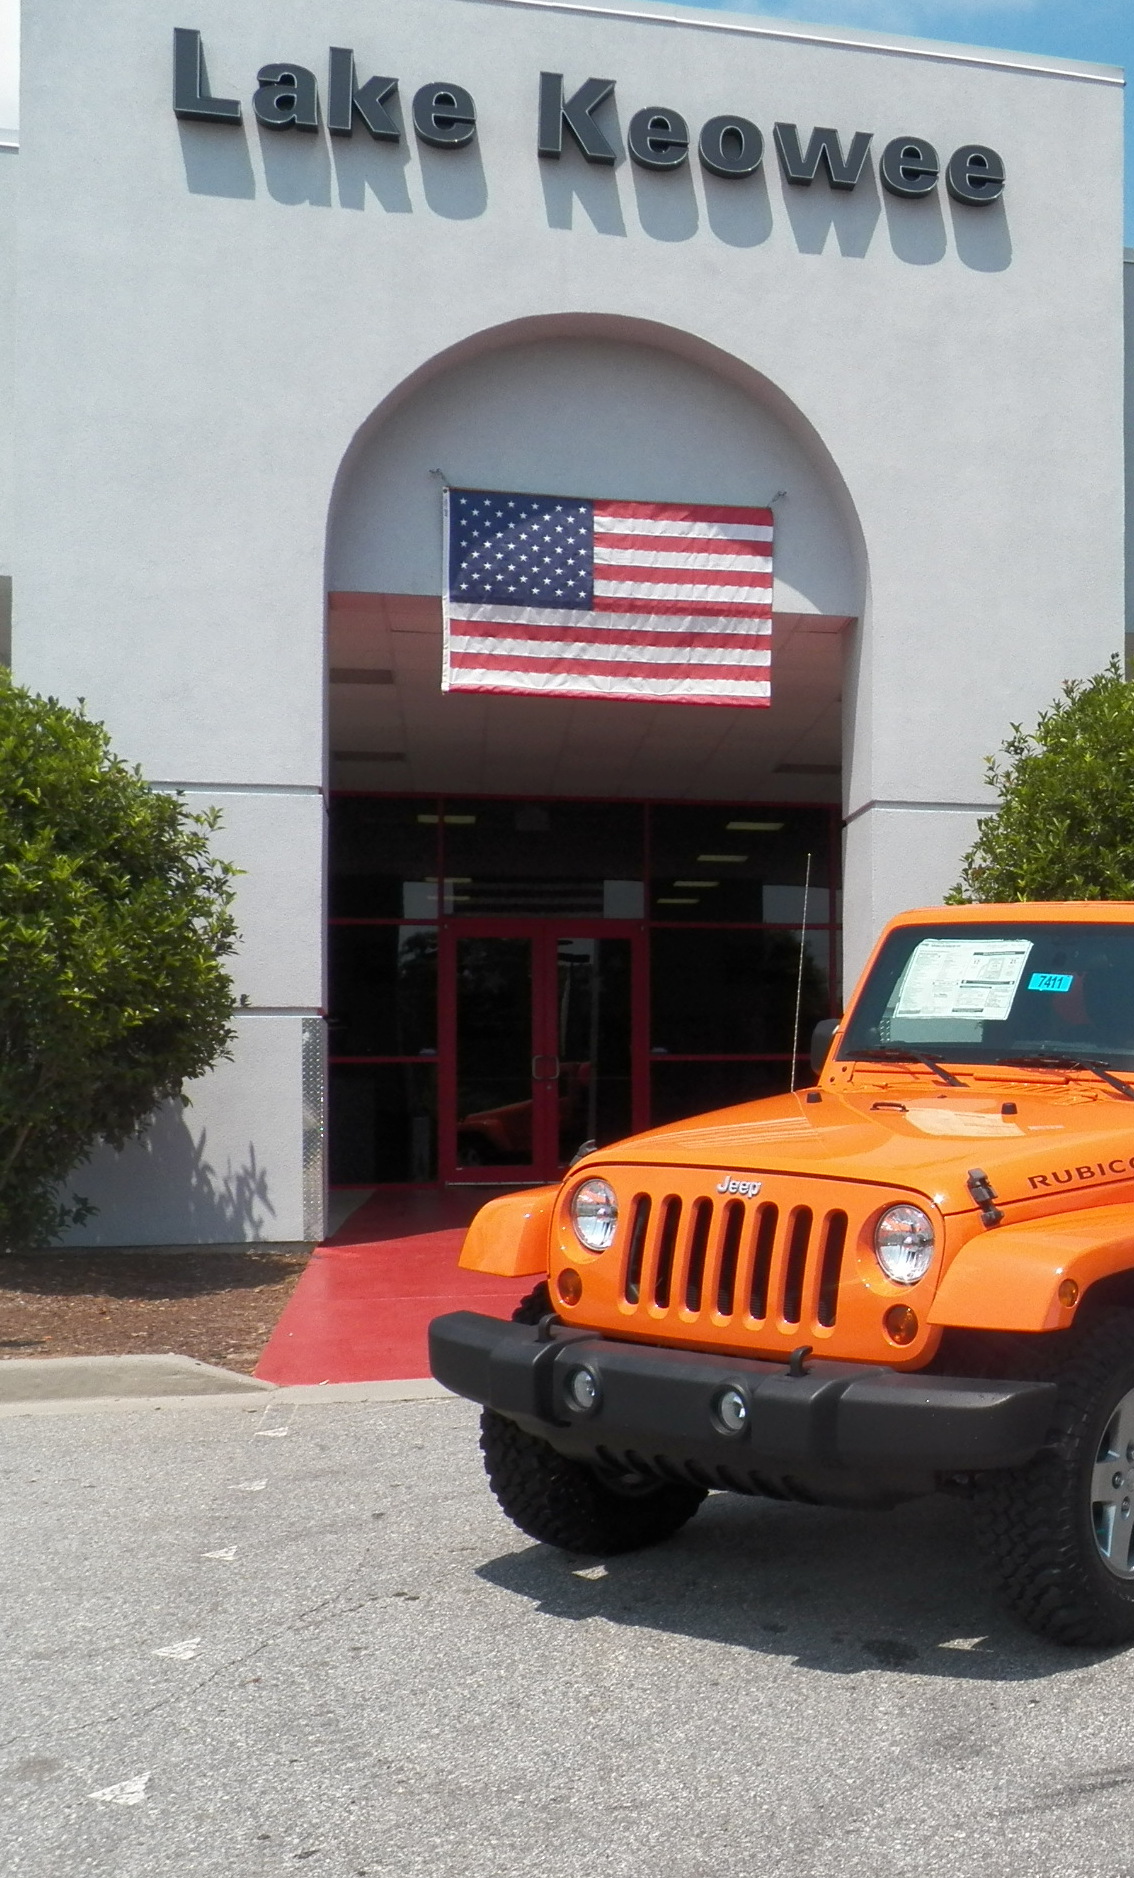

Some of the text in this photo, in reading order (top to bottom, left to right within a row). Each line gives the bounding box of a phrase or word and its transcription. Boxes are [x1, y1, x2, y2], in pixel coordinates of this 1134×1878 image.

[173, 27, 1007, 207] Lake Keowee
[1038, 975, 1064, 989] 7411
[716, 1175, 762, 1199] Jeep
